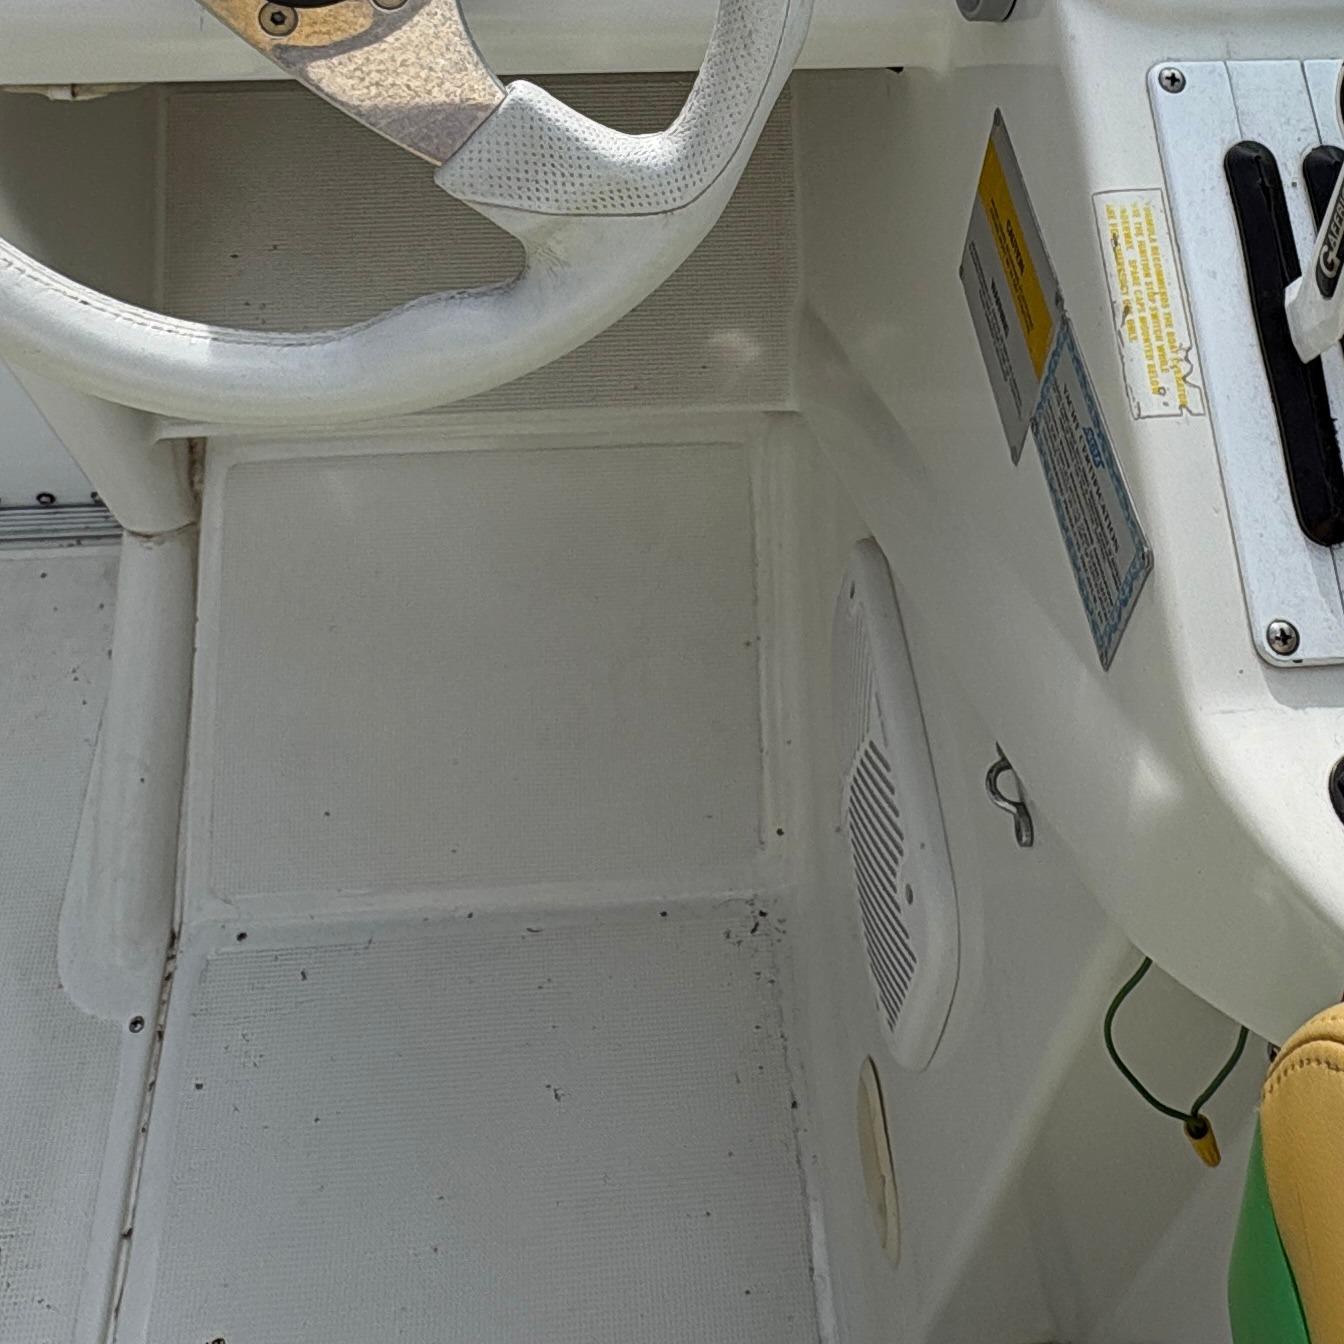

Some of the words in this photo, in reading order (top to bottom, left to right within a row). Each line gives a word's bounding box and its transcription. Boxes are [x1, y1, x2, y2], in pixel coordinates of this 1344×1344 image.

[1127, 259, 1141, 287] SPARE
[1133, 289, 1146, 313] CAPS
[1162, 311, 1173, 328] THE
[1138, 315, 1154, 360] MOUNTED
[1149, 306, 1163, 341] SWITCH
[1156, 343, 1169, 373] WHILE
[1166, 330, 1178, 353] BOAT
[1061, 381, 1080, 433] YACHT
[1077, 429, 1121, 555] CERTIFICATION
